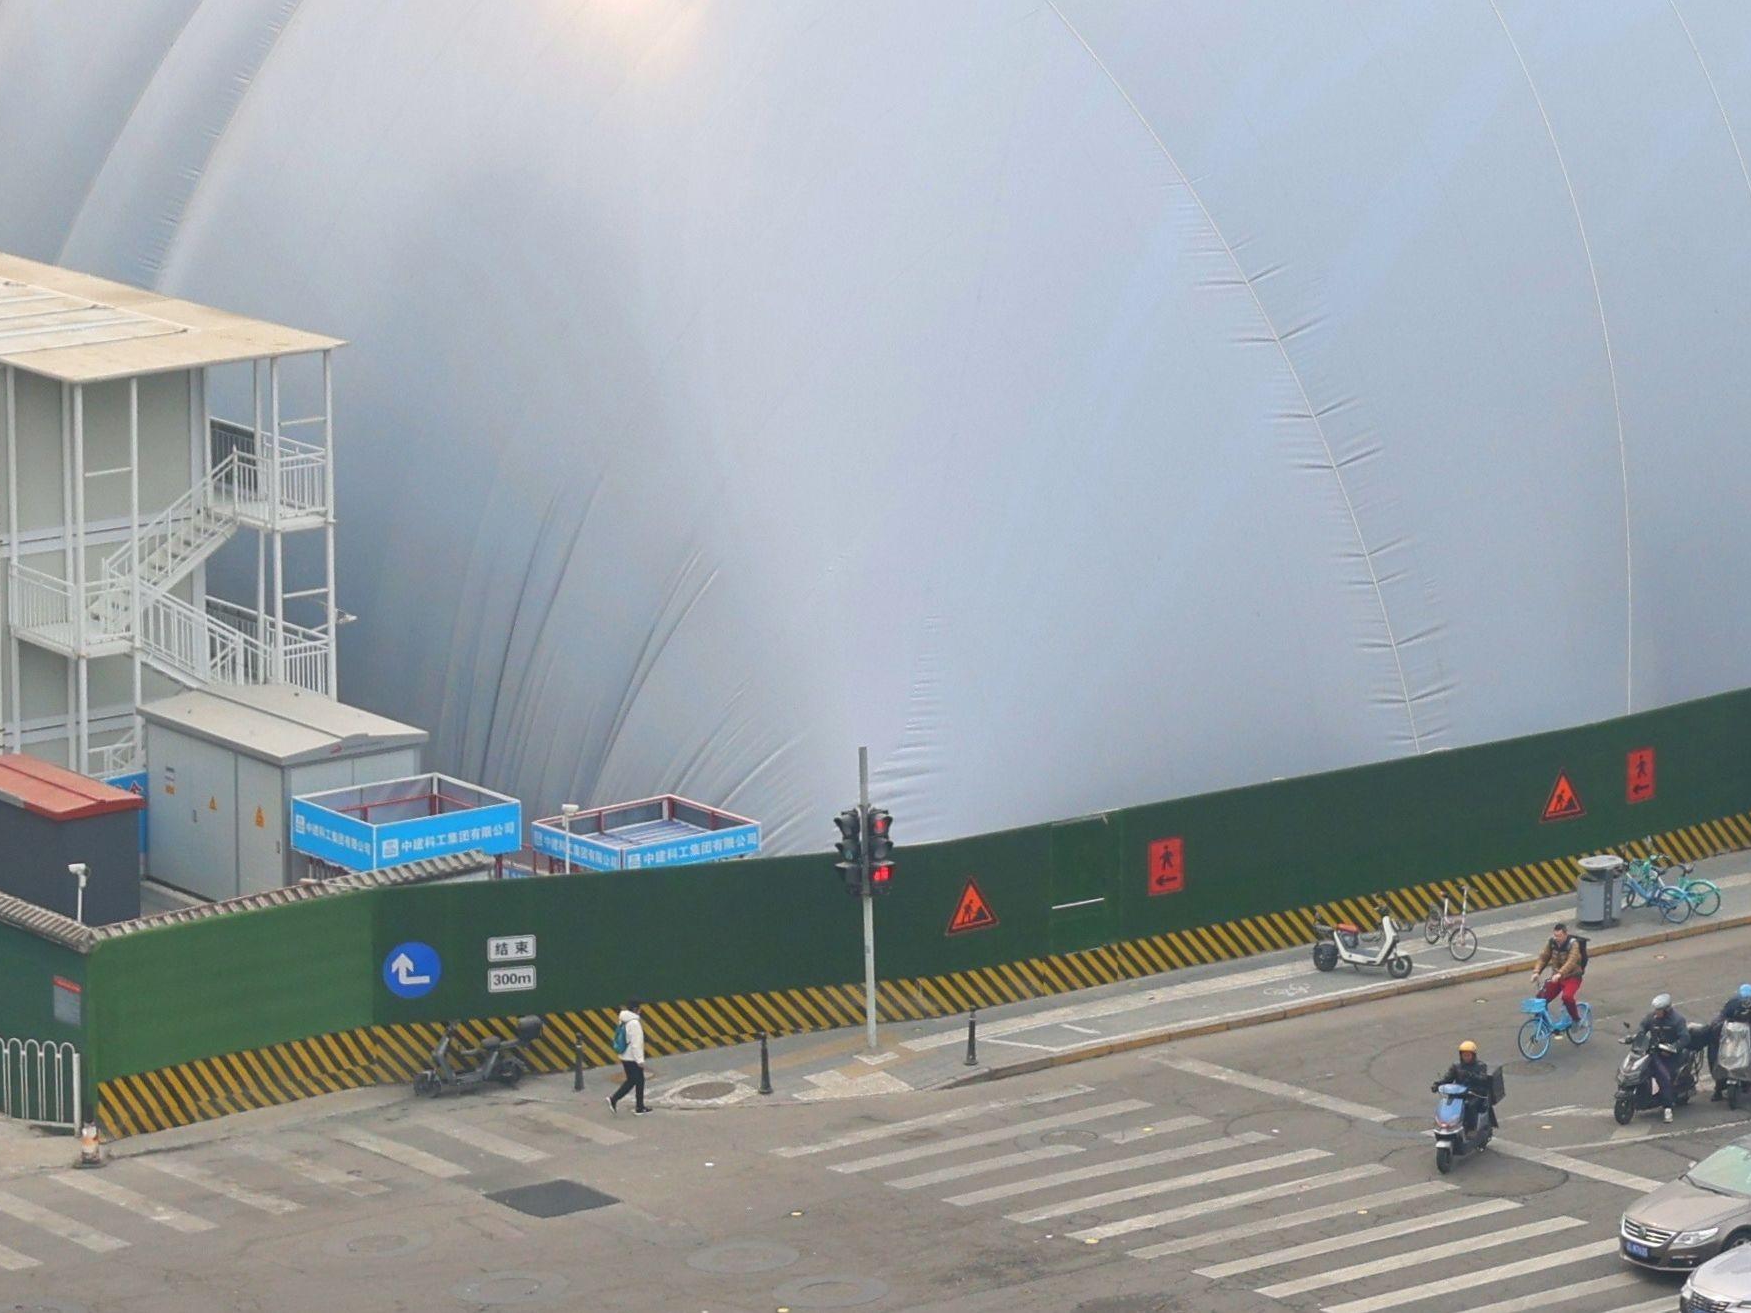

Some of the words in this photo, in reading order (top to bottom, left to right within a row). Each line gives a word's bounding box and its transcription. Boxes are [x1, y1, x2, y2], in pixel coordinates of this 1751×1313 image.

[401, 821, 515, 852] 中建科工集团有限公司
[643, 832, 758, 864] 中建科工集团有限公司
[494, 940, 529, 956] 结束
[493, 973, 531, 986] 300m
